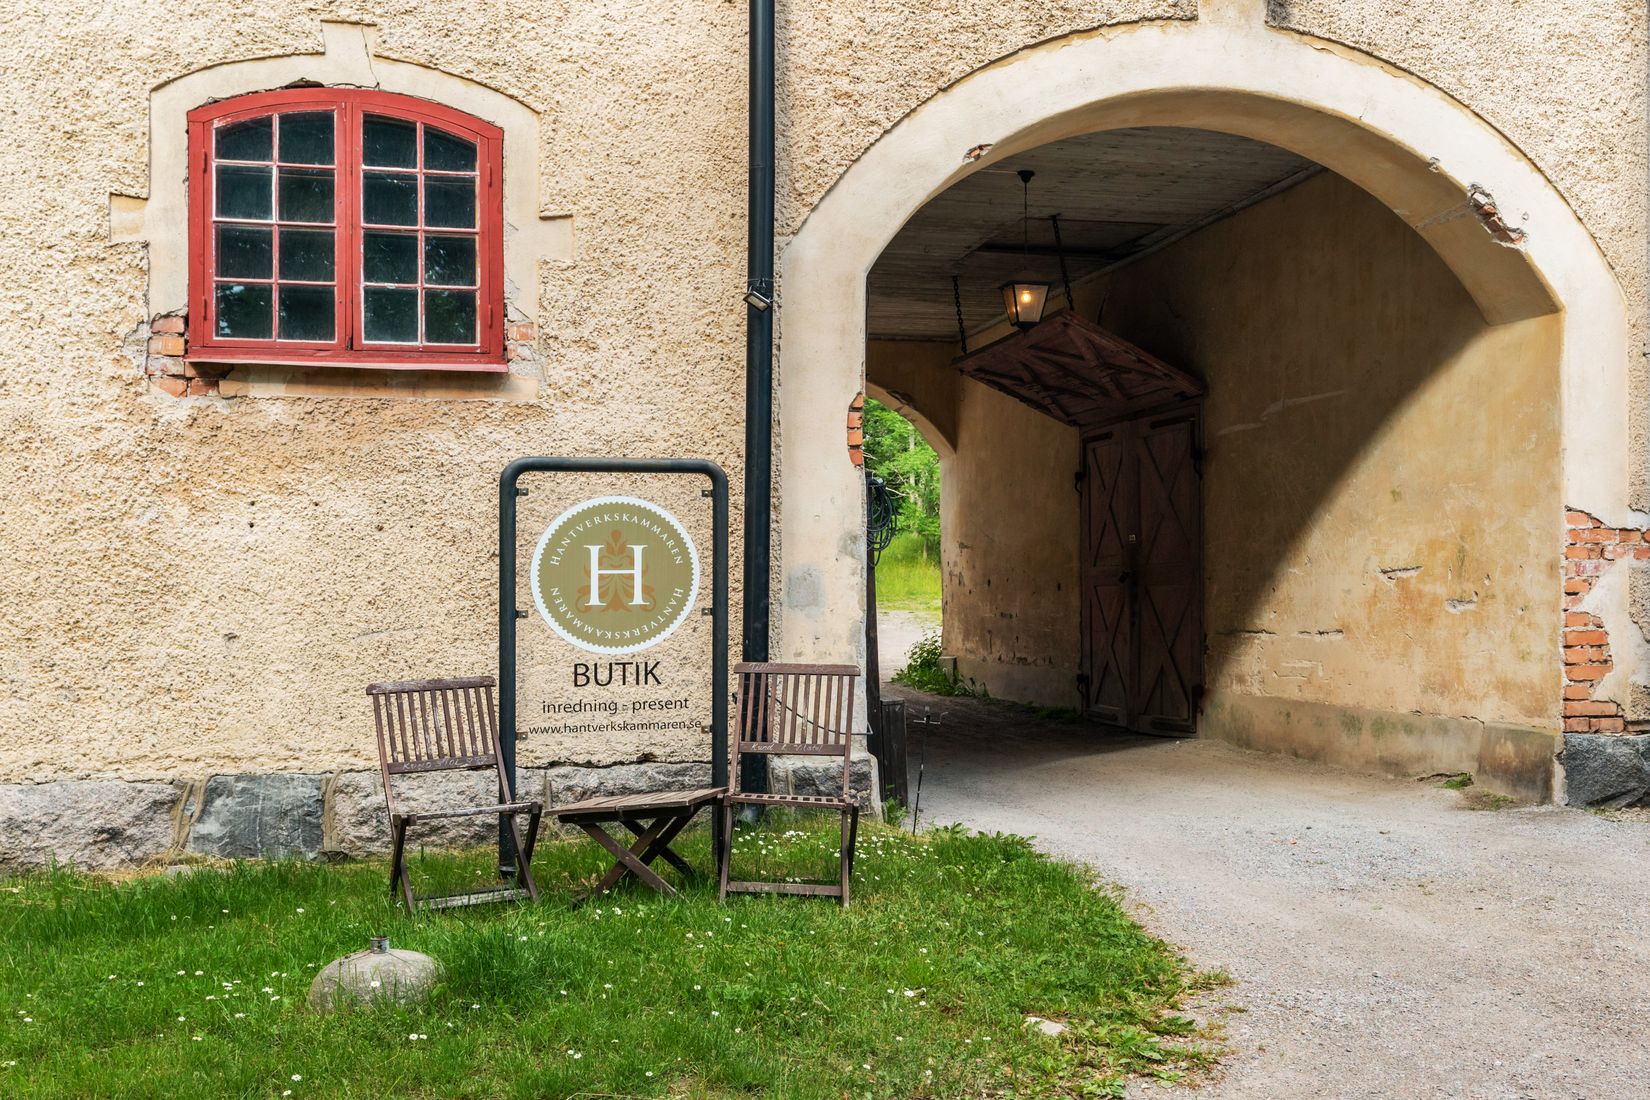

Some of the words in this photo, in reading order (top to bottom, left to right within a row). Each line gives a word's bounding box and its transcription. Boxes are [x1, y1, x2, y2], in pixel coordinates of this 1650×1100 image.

[550, 512, 684, 566] HANTVERKSKAMMAREN
[583, 544, 650, 606] H
[550, 587, 684, 640] HANTVERKSKAMMAREN
[573, 661, 662, 687] BUTIK
[542, 699, 618, 714] inredning
[632, 698, 689, 713] present
[528, 719, 702, 735] www.hantverkskammaren.se
